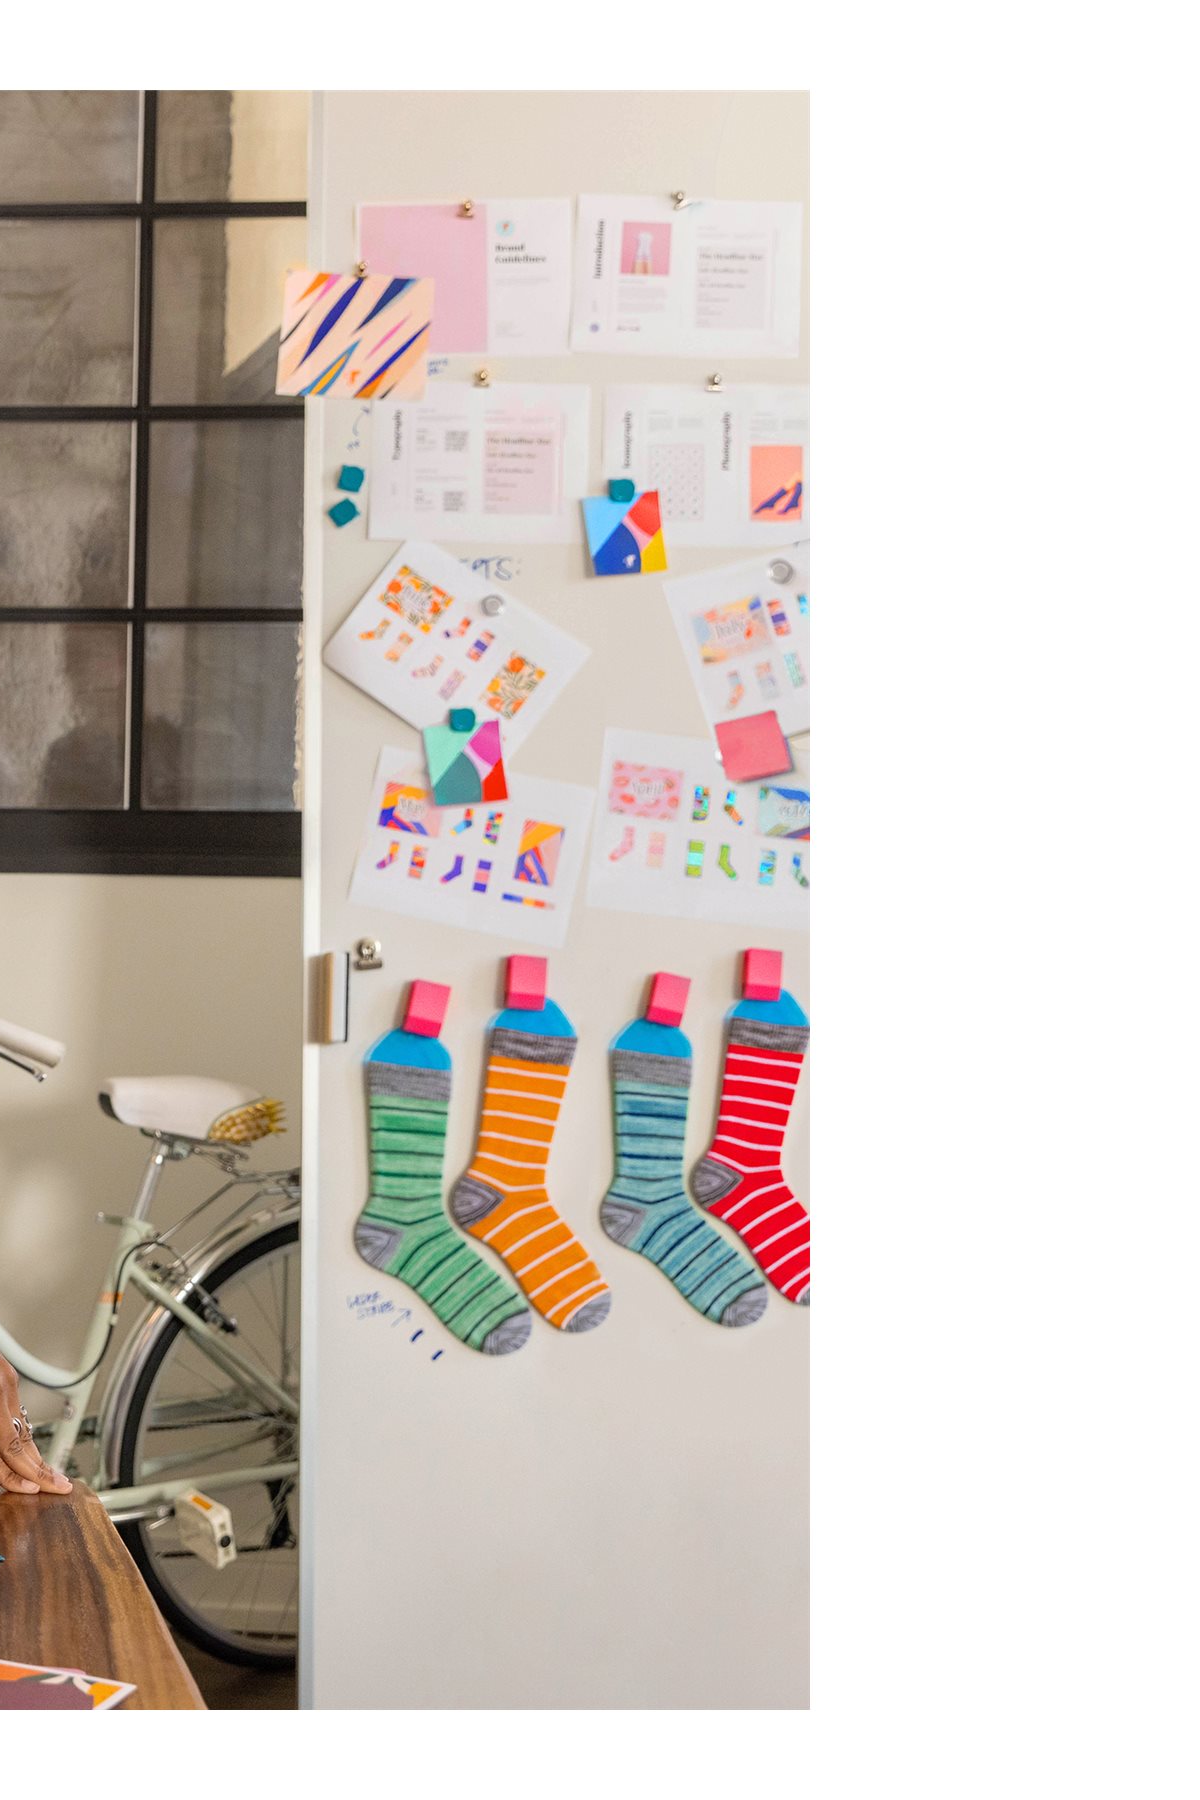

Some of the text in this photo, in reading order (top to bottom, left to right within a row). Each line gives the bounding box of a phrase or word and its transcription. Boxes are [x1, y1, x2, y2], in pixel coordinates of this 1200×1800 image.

[495, 243, 525, 252] Brand
[594, 218, 604, 280] Introduction
[494, 255, 547, 264] Guidelines
